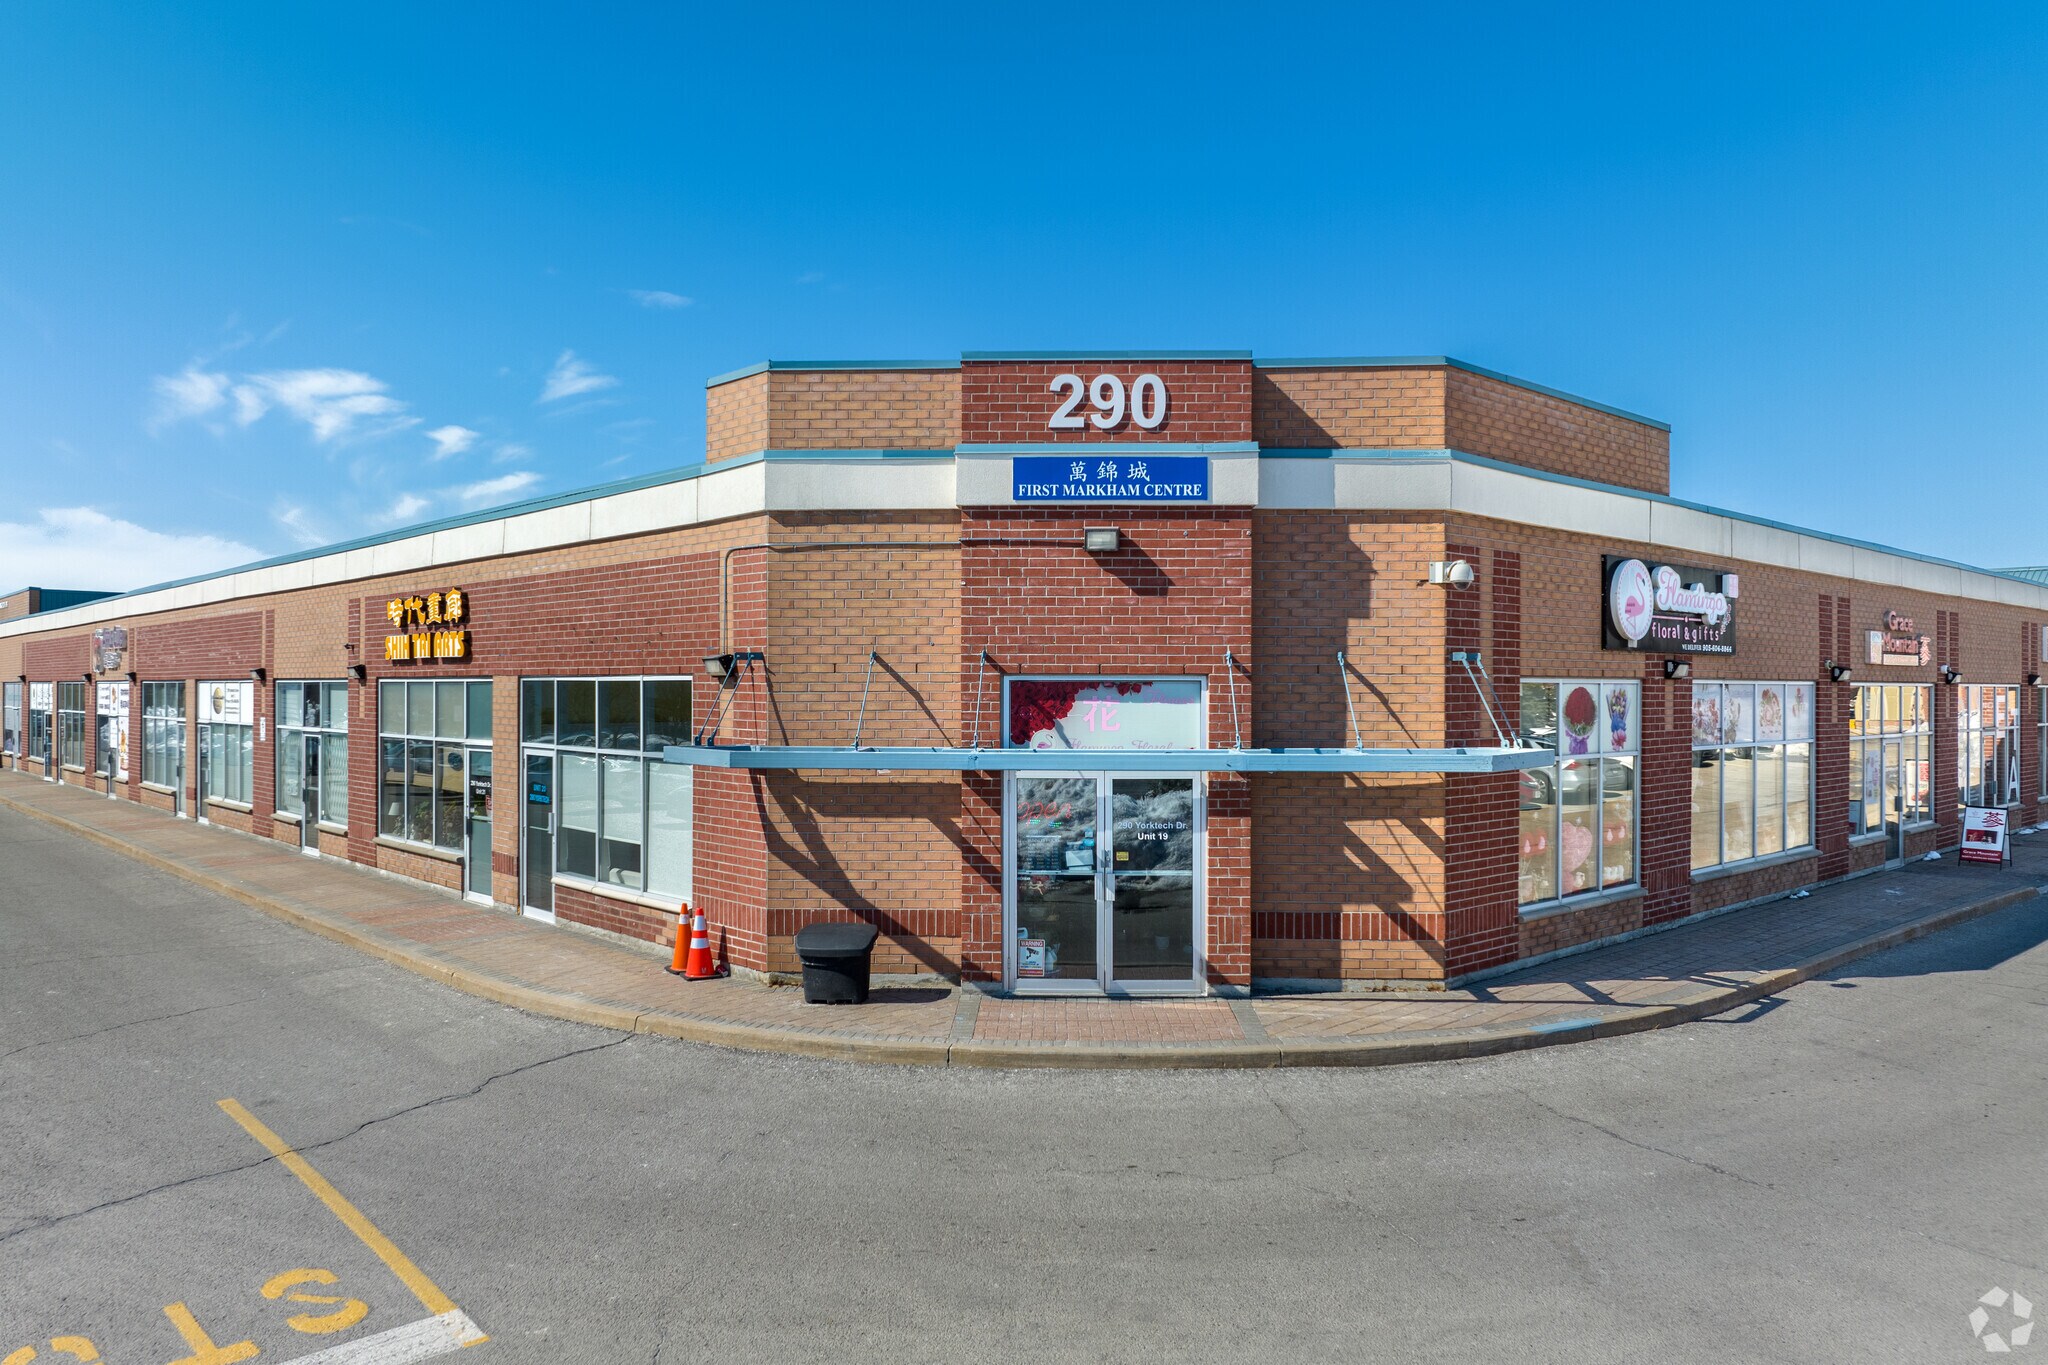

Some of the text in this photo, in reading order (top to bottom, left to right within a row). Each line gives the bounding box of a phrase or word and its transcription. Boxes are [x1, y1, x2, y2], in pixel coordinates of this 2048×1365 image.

[1048, 374, 1166, 429] 290
[1069, 460, 1150, 482] 萬錦城
[1018, 484, 1202, 497] FIRST MARKHAM CENTRE
[1660, 571, 1723, 619] Flamingo
[1652, 622, 1680, 639] floral
[1889, 610, 1913, 632] Grace
[385, 631, 464, 660] SHIH TAI ARTS
[1083, 695, 1121, 732] 花
[1118, 821, 1188, 829] 290 Yorktech Dr.
[1137, 832, 1168, 840] Unit 19
